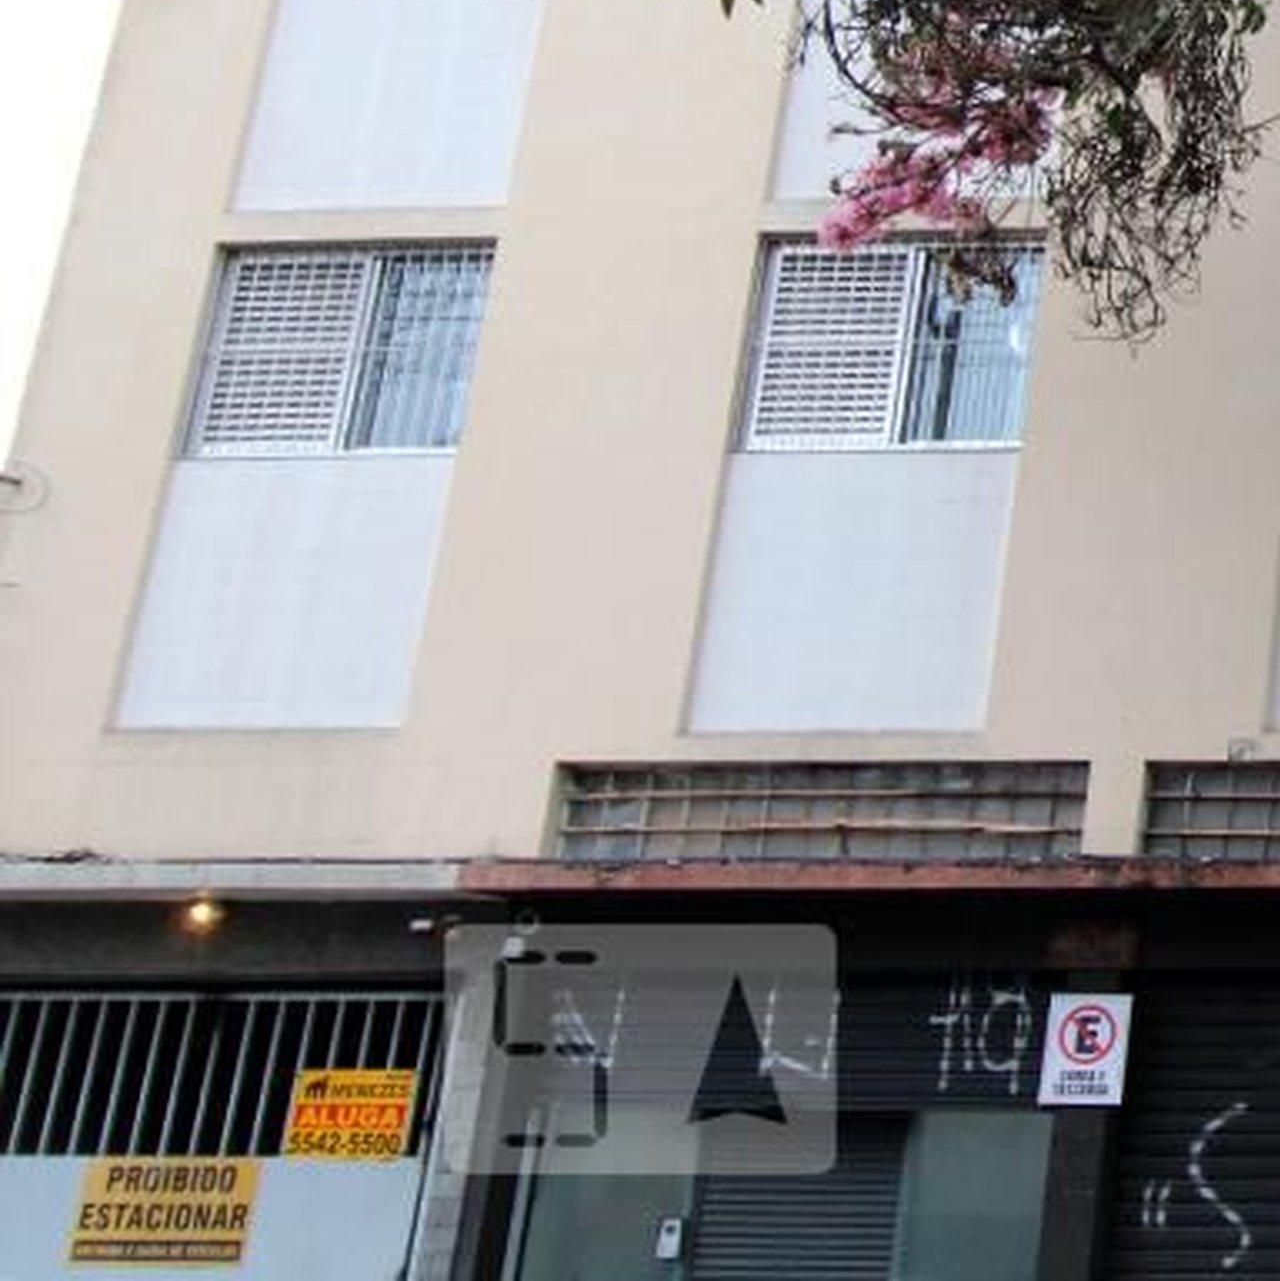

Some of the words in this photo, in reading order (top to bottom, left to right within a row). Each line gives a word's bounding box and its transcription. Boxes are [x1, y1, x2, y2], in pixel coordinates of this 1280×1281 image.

[298, 1106, 402, 1126] ALUGA
[288, 1130, 402, 1155] 5542-5500
[105, 1165, 238, 1194] PROIBIDO
[79, 1202, 249, 1231] ESTACIONAR
